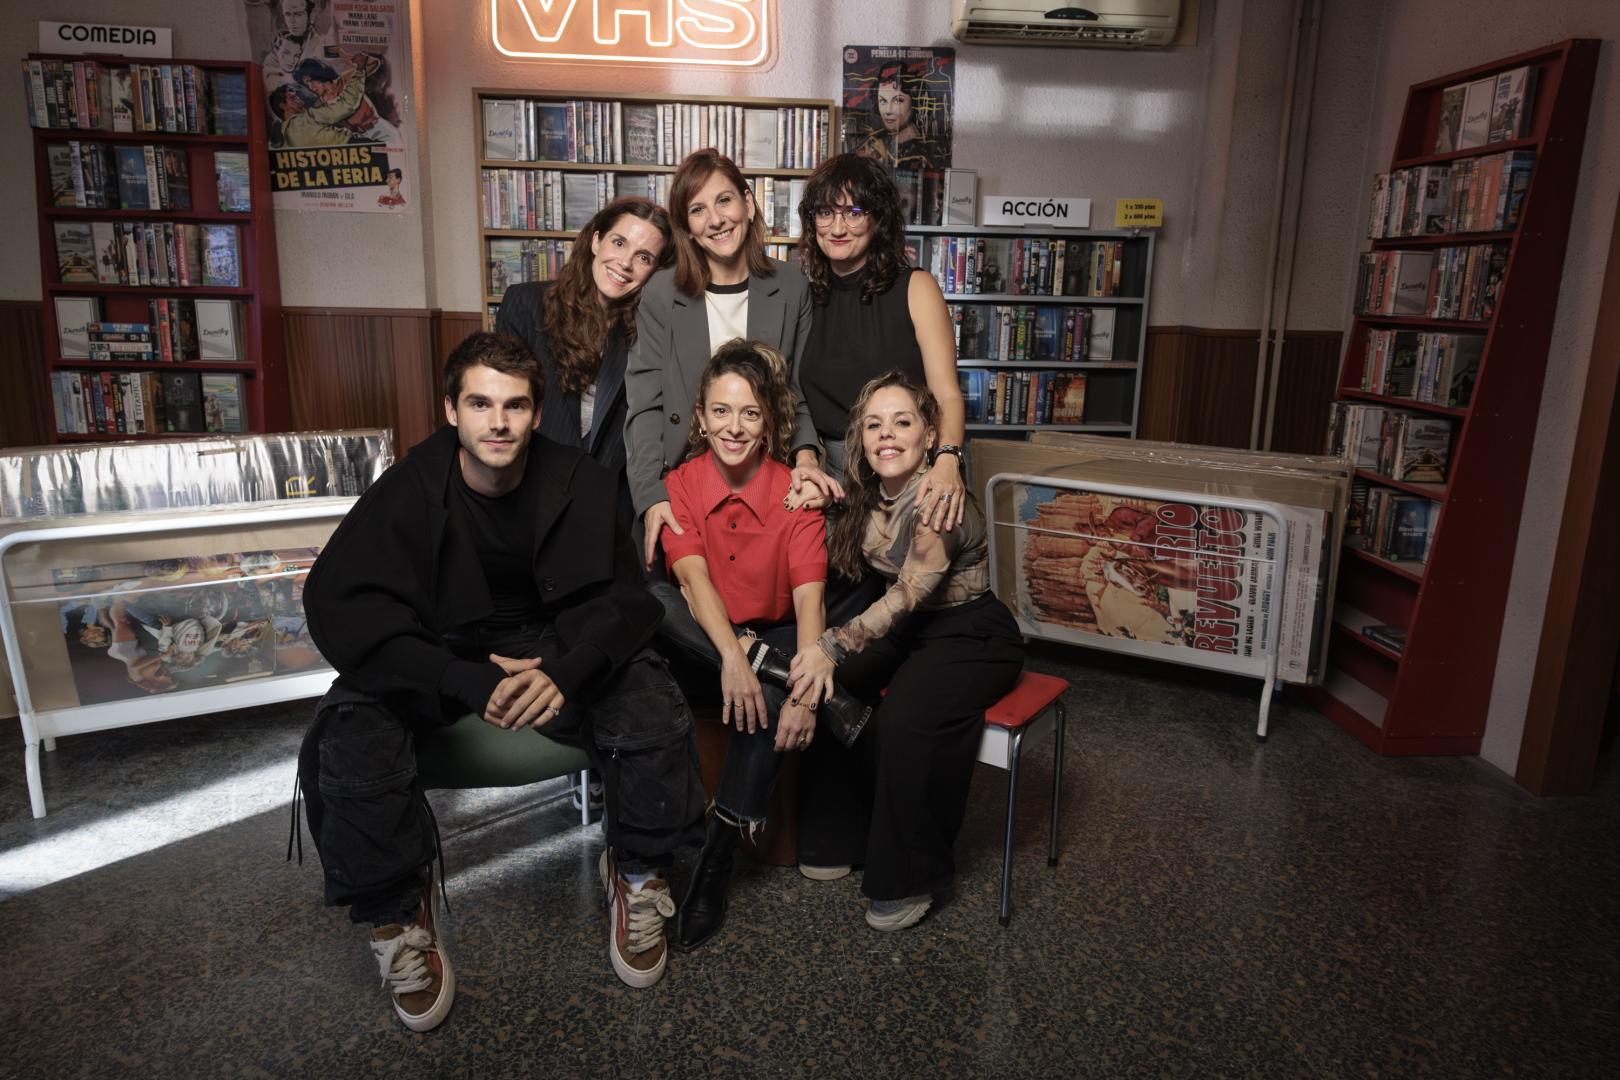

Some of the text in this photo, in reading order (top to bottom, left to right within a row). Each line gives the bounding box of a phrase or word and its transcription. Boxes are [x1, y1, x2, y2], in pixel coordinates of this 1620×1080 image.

[58, 24, 156, 46] COMEDIA
[277, 147, 372, 169] HISTORIAS
[276, 166, 383, 189] DE LA FERIA
[1002, 198, 1069, 218] ACCIÓN
[132, 383, 143, 416] TITANIC
[1155, 504, 1198, 560] RIO
[1192, 508, 1247, 656] REVUELTO
